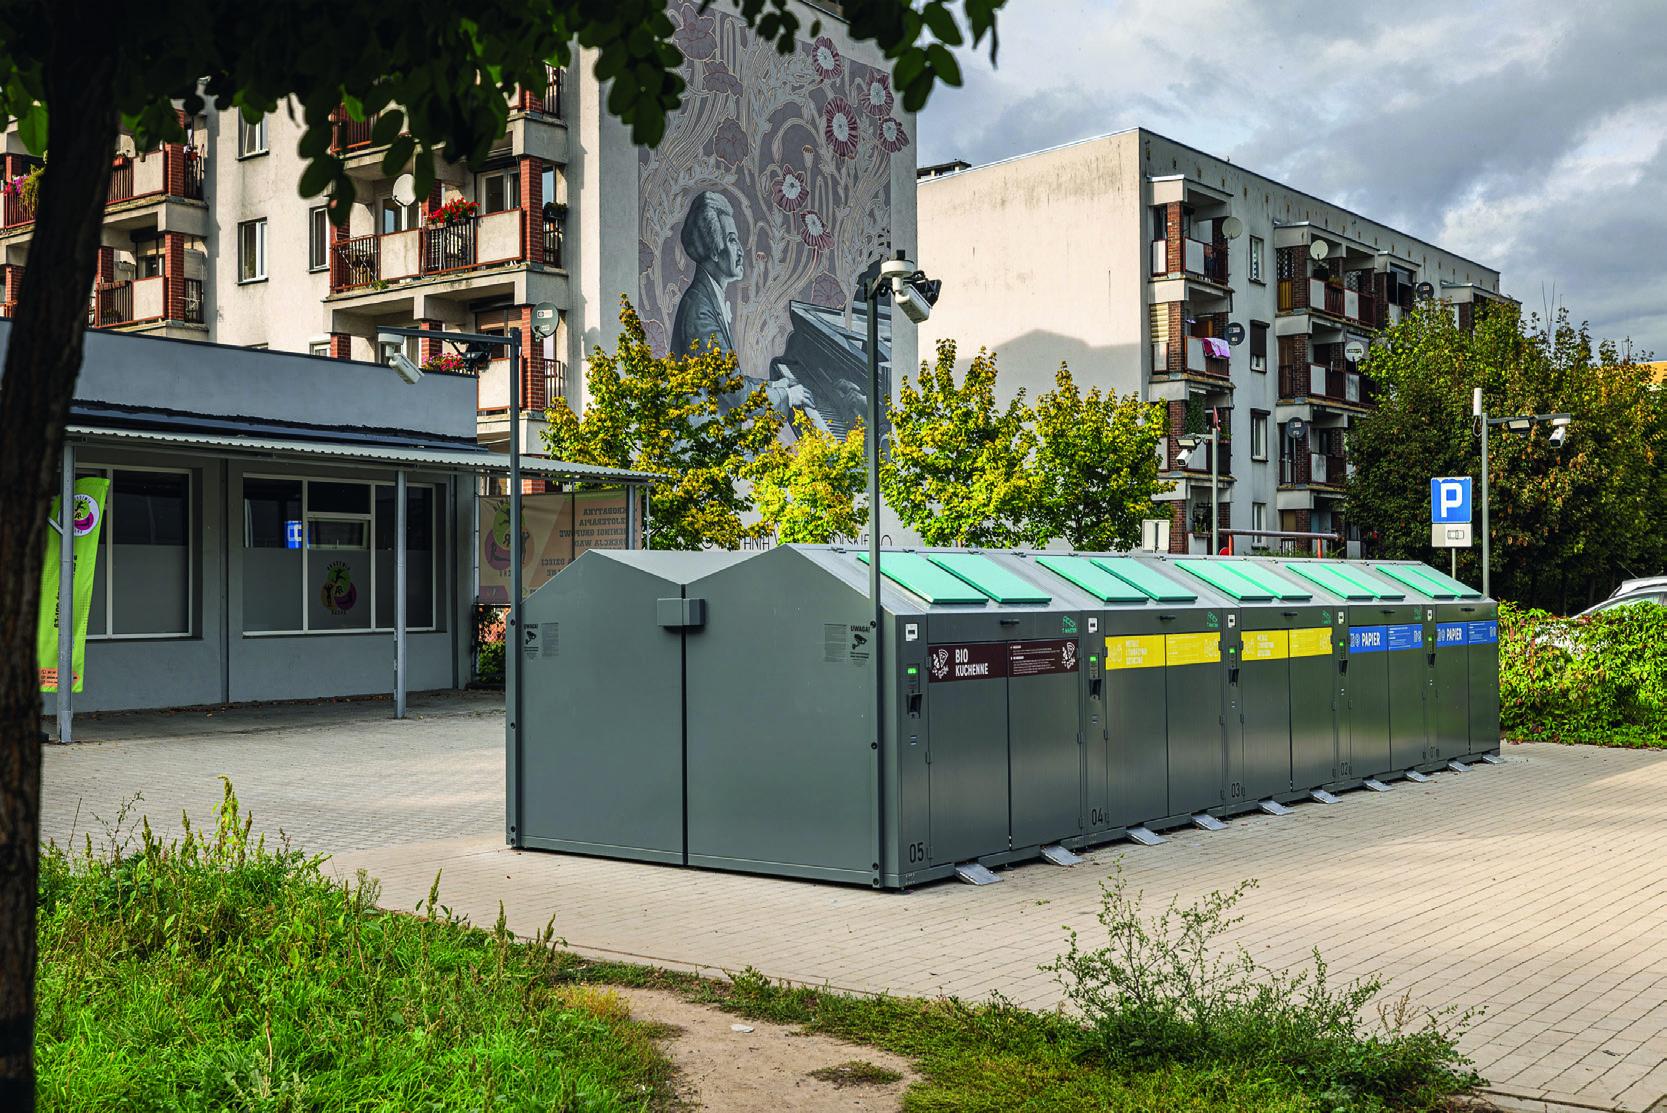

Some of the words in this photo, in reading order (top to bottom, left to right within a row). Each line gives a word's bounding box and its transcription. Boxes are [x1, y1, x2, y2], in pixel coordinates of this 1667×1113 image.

[1441, 483, 1462, 517] P
[1361, 631, 1381, 647] PAPIER
[1446, 627, 1463, 642] PAPIER
[955, 648, 969, 663] BIO
[955, 662, 989, 677] KUCHENNE
[1231, 782, 1241, 798] 03
[1091, 807, 1104, 826] 04
[909, 841, 924, 864] 05
